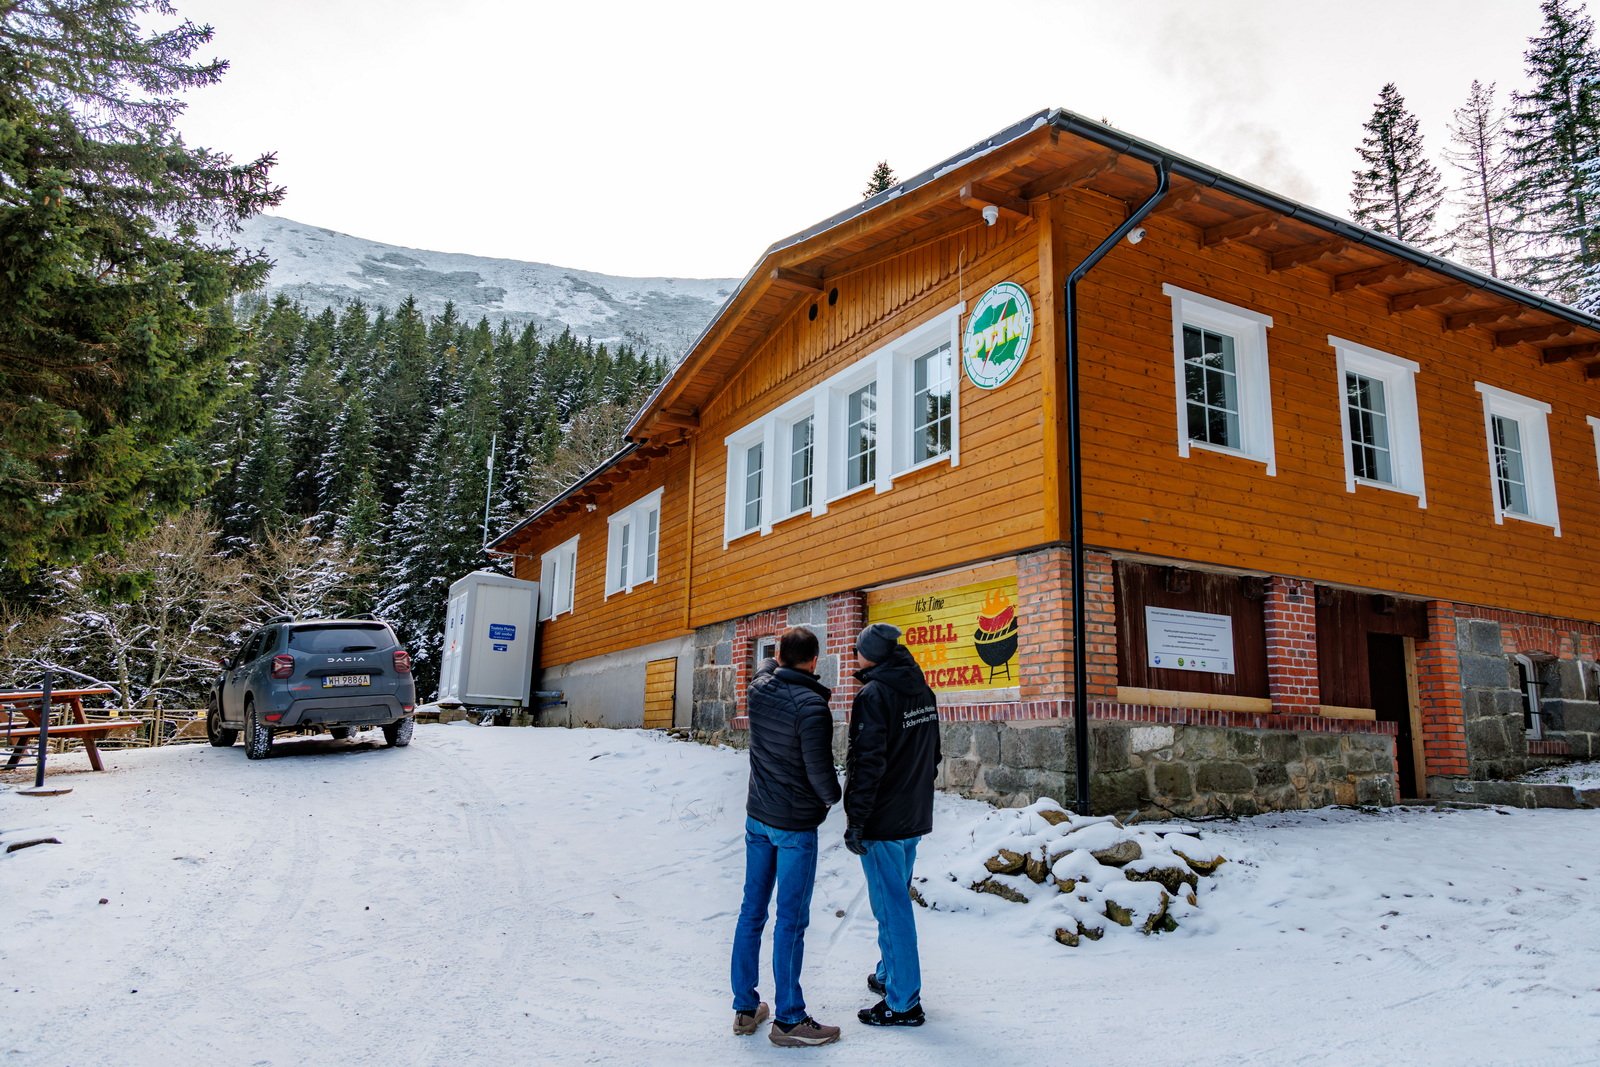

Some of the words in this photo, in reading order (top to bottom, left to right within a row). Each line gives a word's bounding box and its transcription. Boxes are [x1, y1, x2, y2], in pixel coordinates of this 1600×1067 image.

[969, 309, 1022, 359] PTTK
[915, 597, 927, 613] It's
[928, 596, 945, 611] Time
[926, 614, 934, 624] To
[905, 623, 958, 646] GRILL
[329, 676, 340, 685] WH
[342, 675, 369, 684] 9886A
